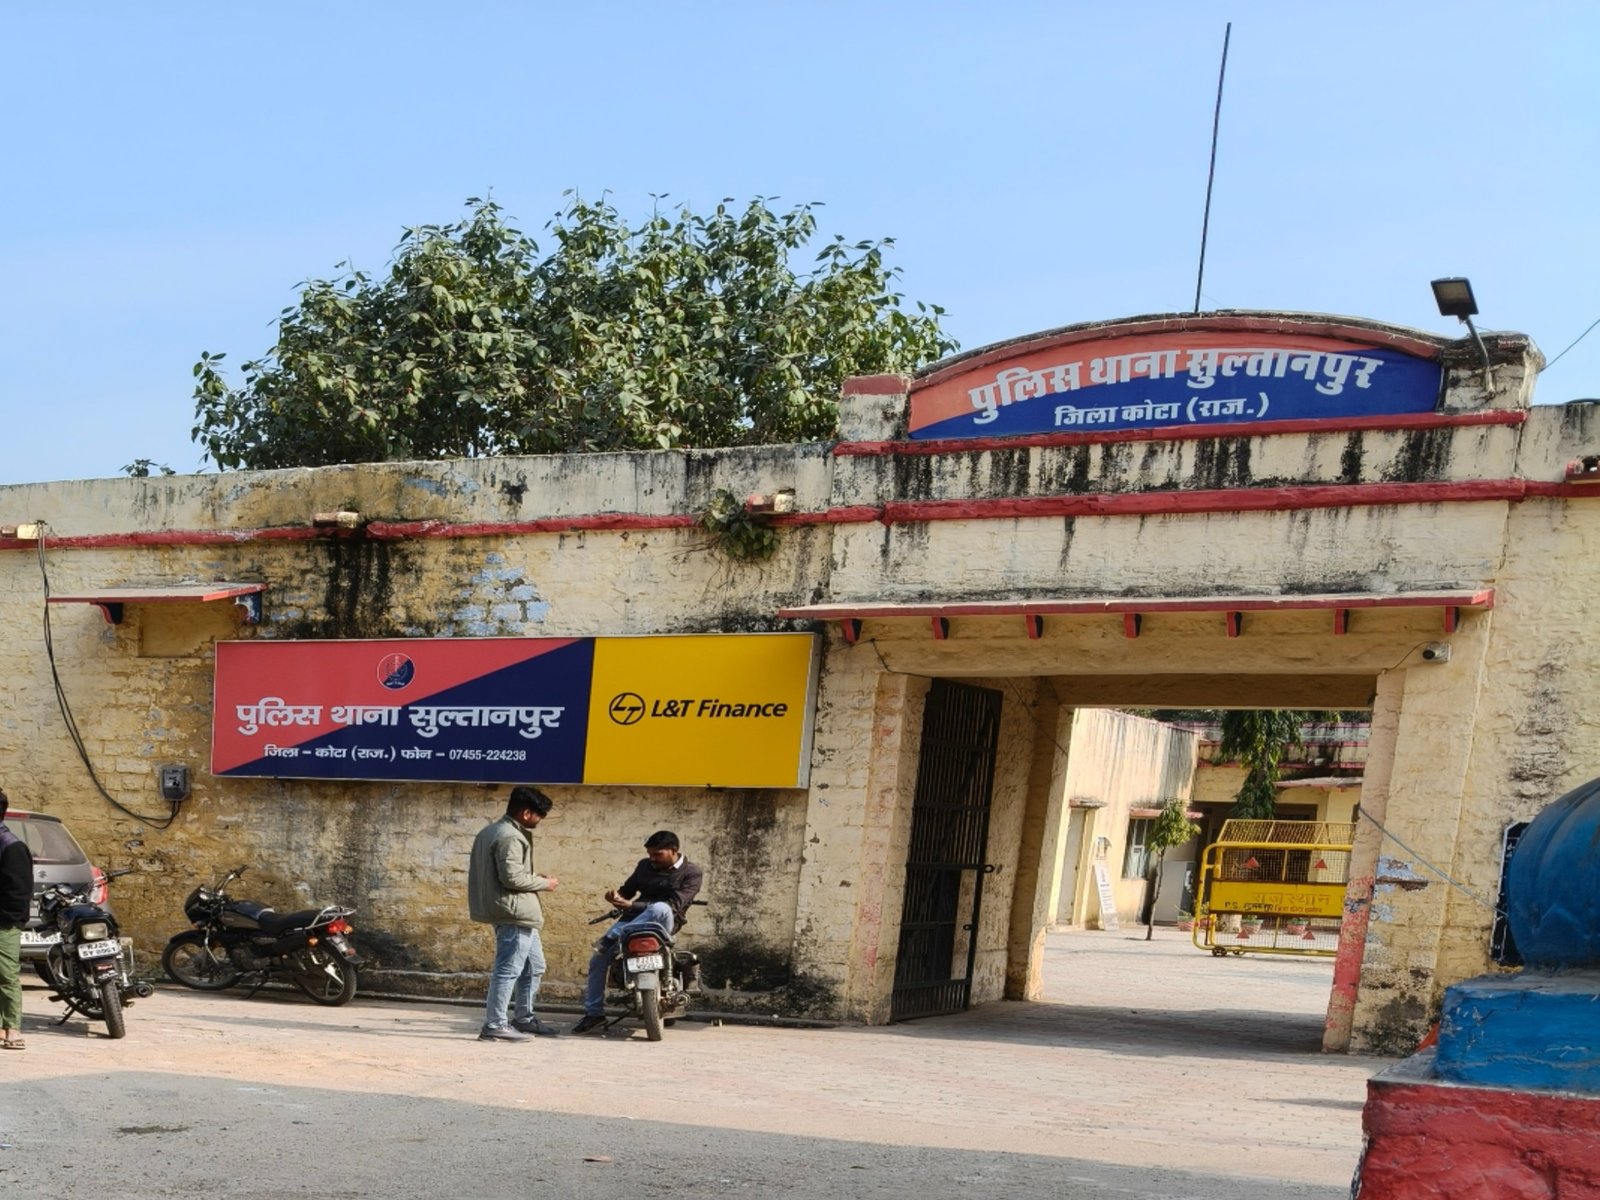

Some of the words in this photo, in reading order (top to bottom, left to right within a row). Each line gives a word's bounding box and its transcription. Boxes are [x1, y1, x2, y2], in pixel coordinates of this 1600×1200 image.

[968, 361, 1083, 424] पुलिस
[1090, 350, 1181, 385] थाना
[1186, 348, 1385, 396] सुल्तानपुर
[1055, 405, 1118, 426] जिला
[1121, 399, 1181, 421] कोटा
[1186, 392, 1269, 422] (राज.)
[236, 697, 323, 735] पुलिस
[331, 705, 402, 726] थाना
[408, 706, 565, 739] सुल्तानपुर
[651, 699, 695, 718] L&T
[697, 699, 788, 718] Finance
[264, 743, 299, 757] जिला
[315, 744, 347, 758] कोटा
[351, 745, 396, 762] (राज.)
[401, 746, 432, 759] फोन
[449, 749, 527, 761] 07455-224238
